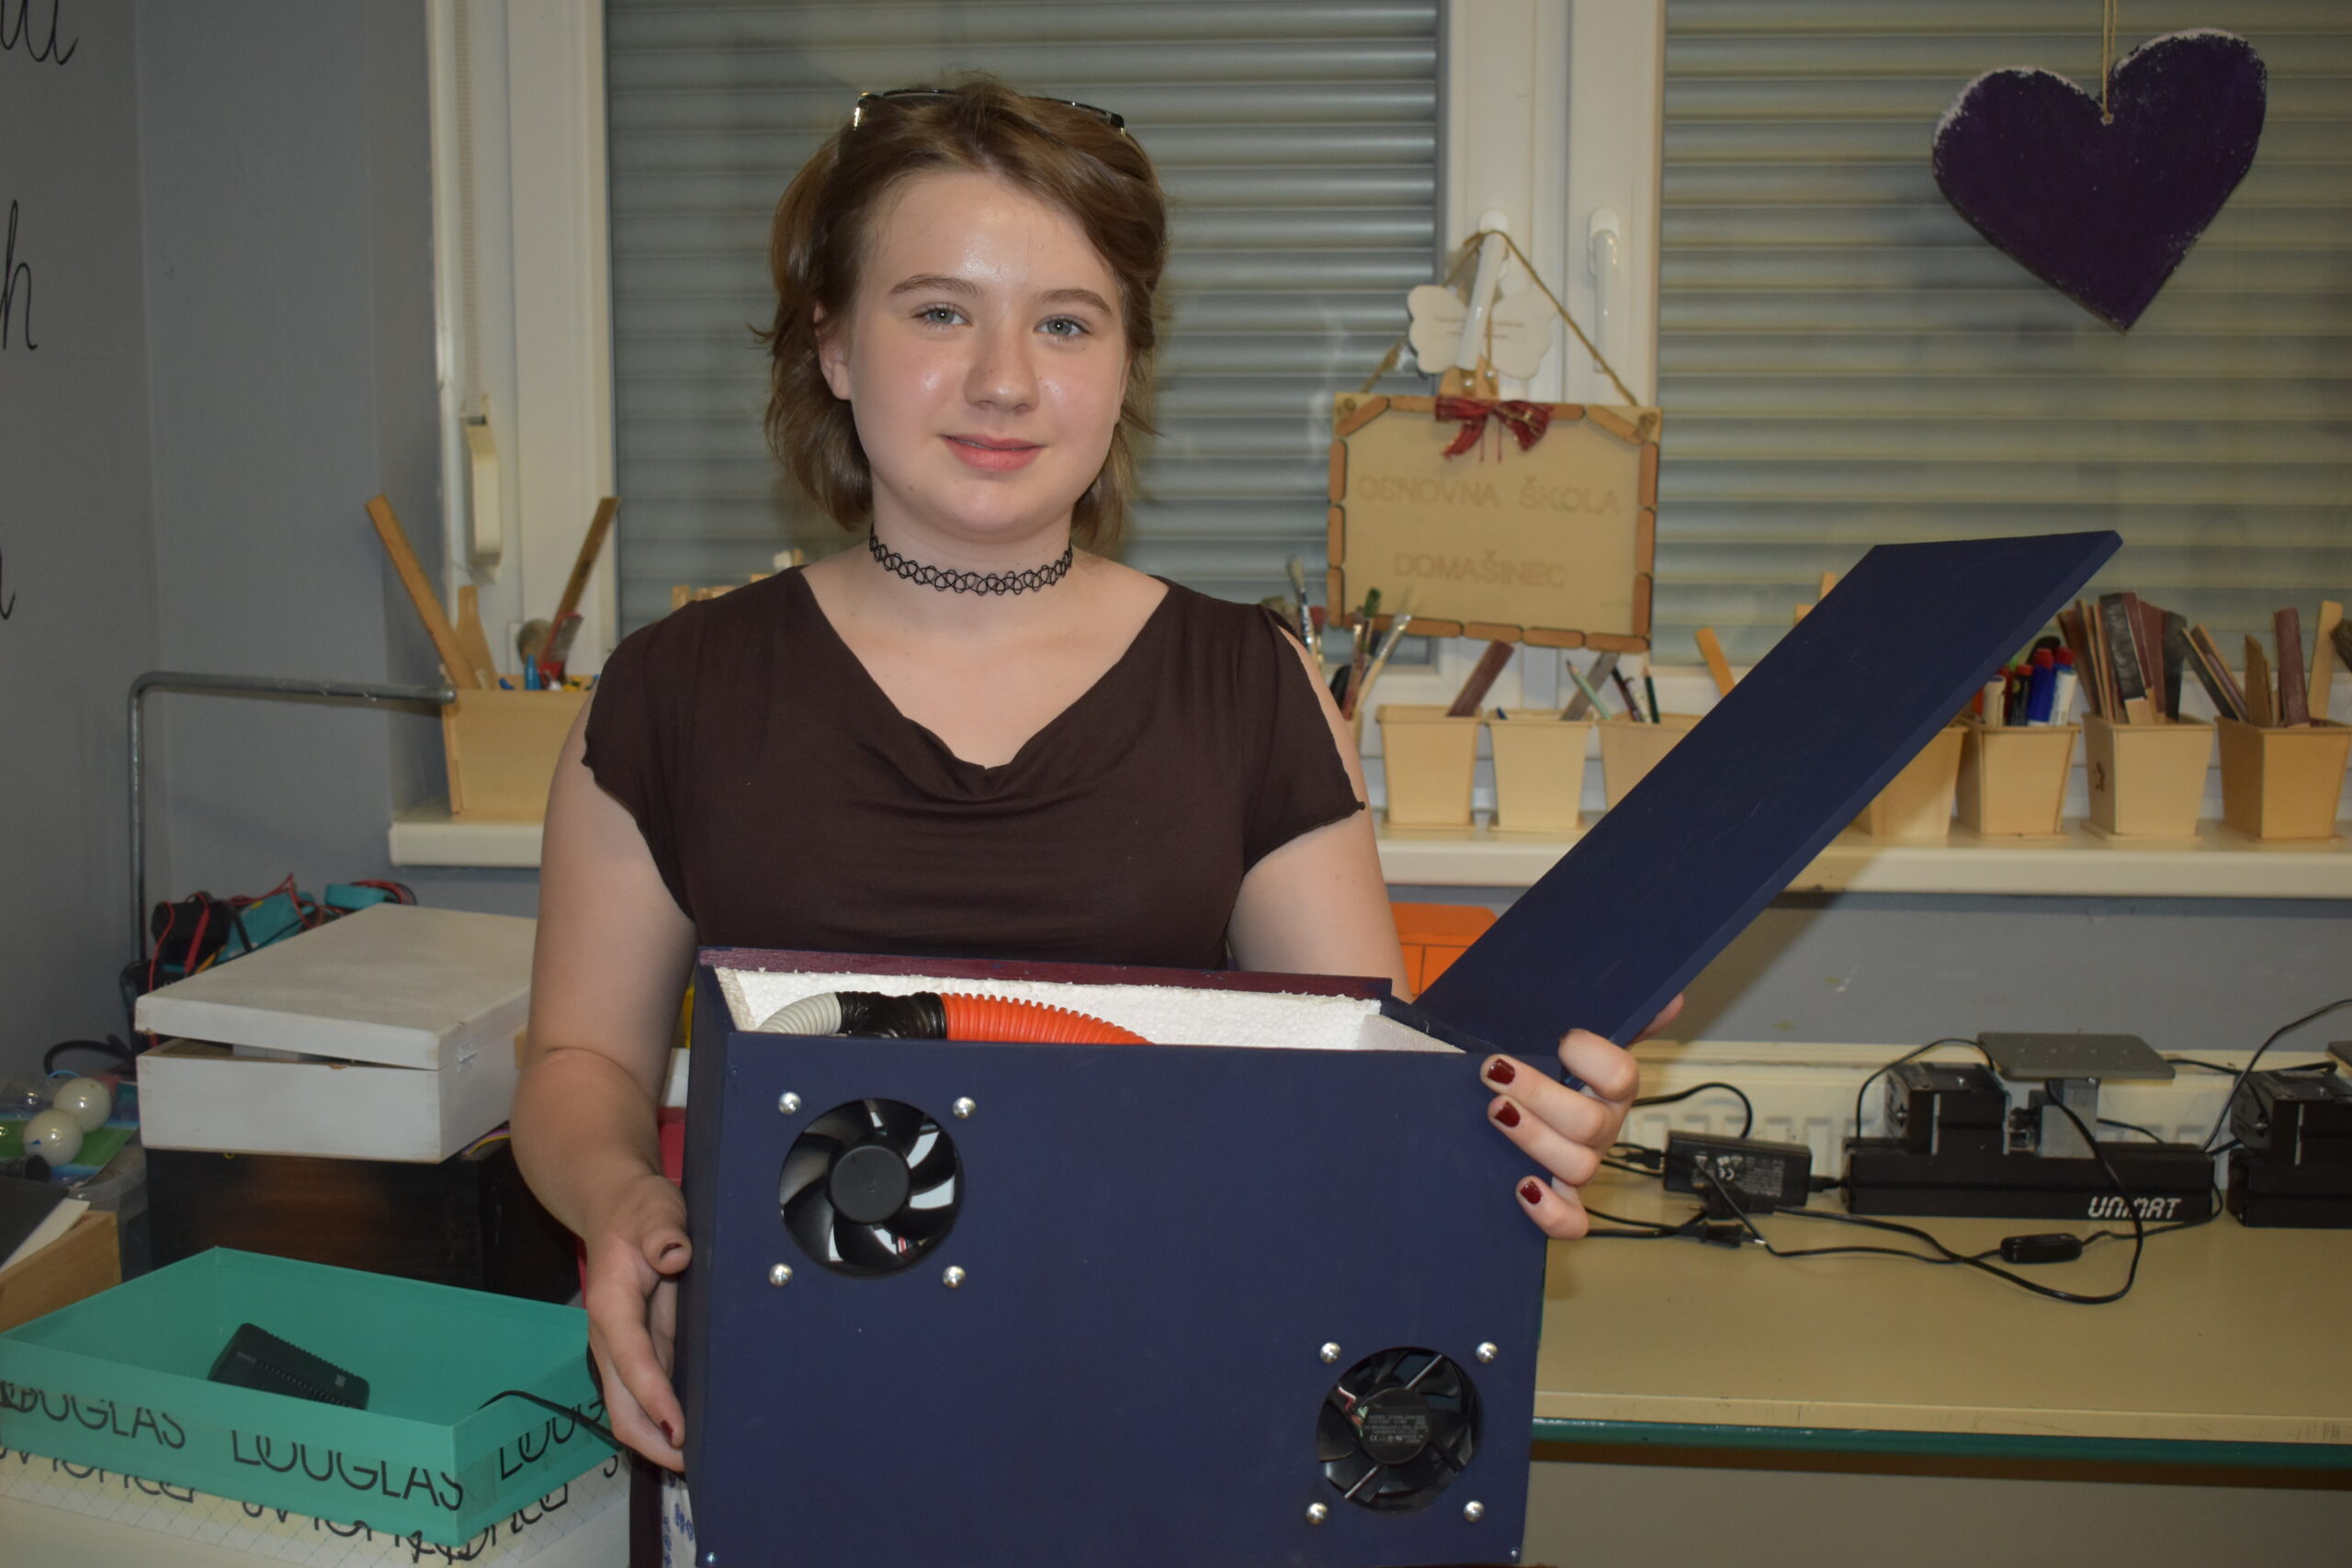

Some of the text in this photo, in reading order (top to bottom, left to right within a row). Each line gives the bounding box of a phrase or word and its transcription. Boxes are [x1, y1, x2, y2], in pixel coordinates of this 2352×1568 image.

[1356, 474, 1620, 515] OSNOVNA ŠKOLA
[1393, 548, 1567, 589] DOMAŠINEC
